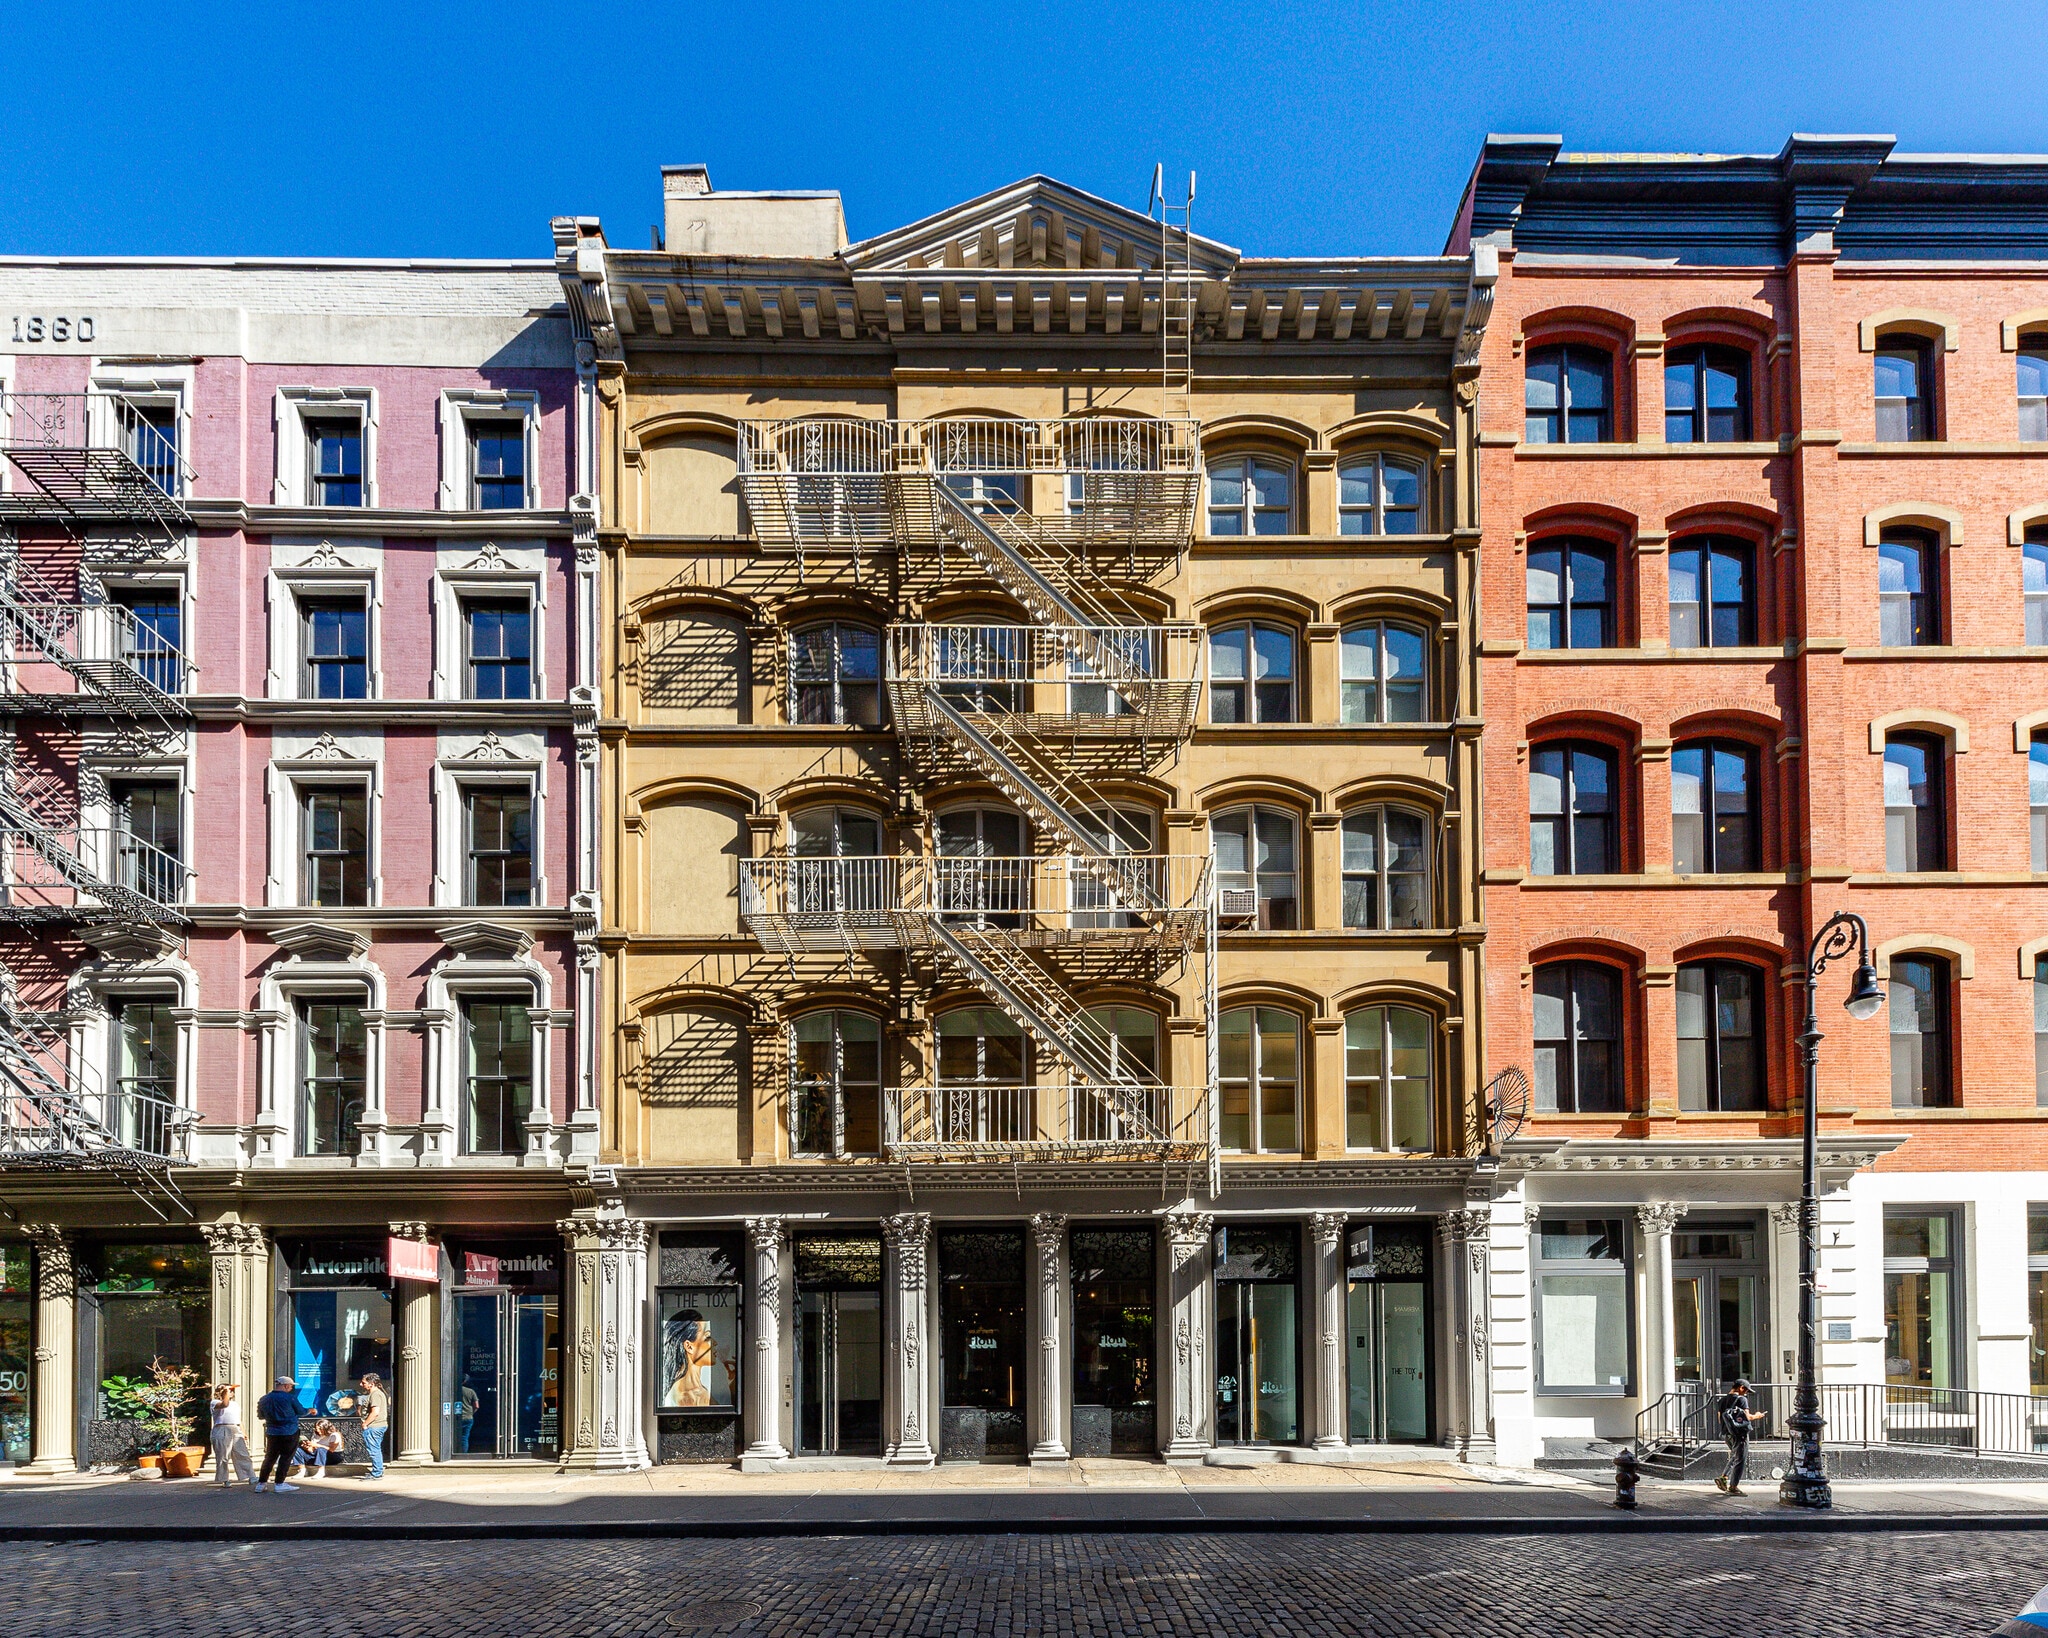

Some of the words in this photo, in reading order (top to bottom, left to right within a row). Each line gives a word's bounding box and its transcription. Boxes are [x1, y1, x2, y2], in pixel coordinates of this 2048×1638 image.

[12, 316, 96, 342] 1860
[301, 1257, 388, 1275] Artemide
[464, 1255, 554, 1272] Artemide
[675, 1294, 698, 1307] THE
[705, 1294, 728, 1307] TOX
[539, 1368, 557, 1380] 46
[1405, 1367, 1417, 1377] TOX
[0, 1371, 27, 1391] 50
[1218, 1375, 1237, 1385] 42A
